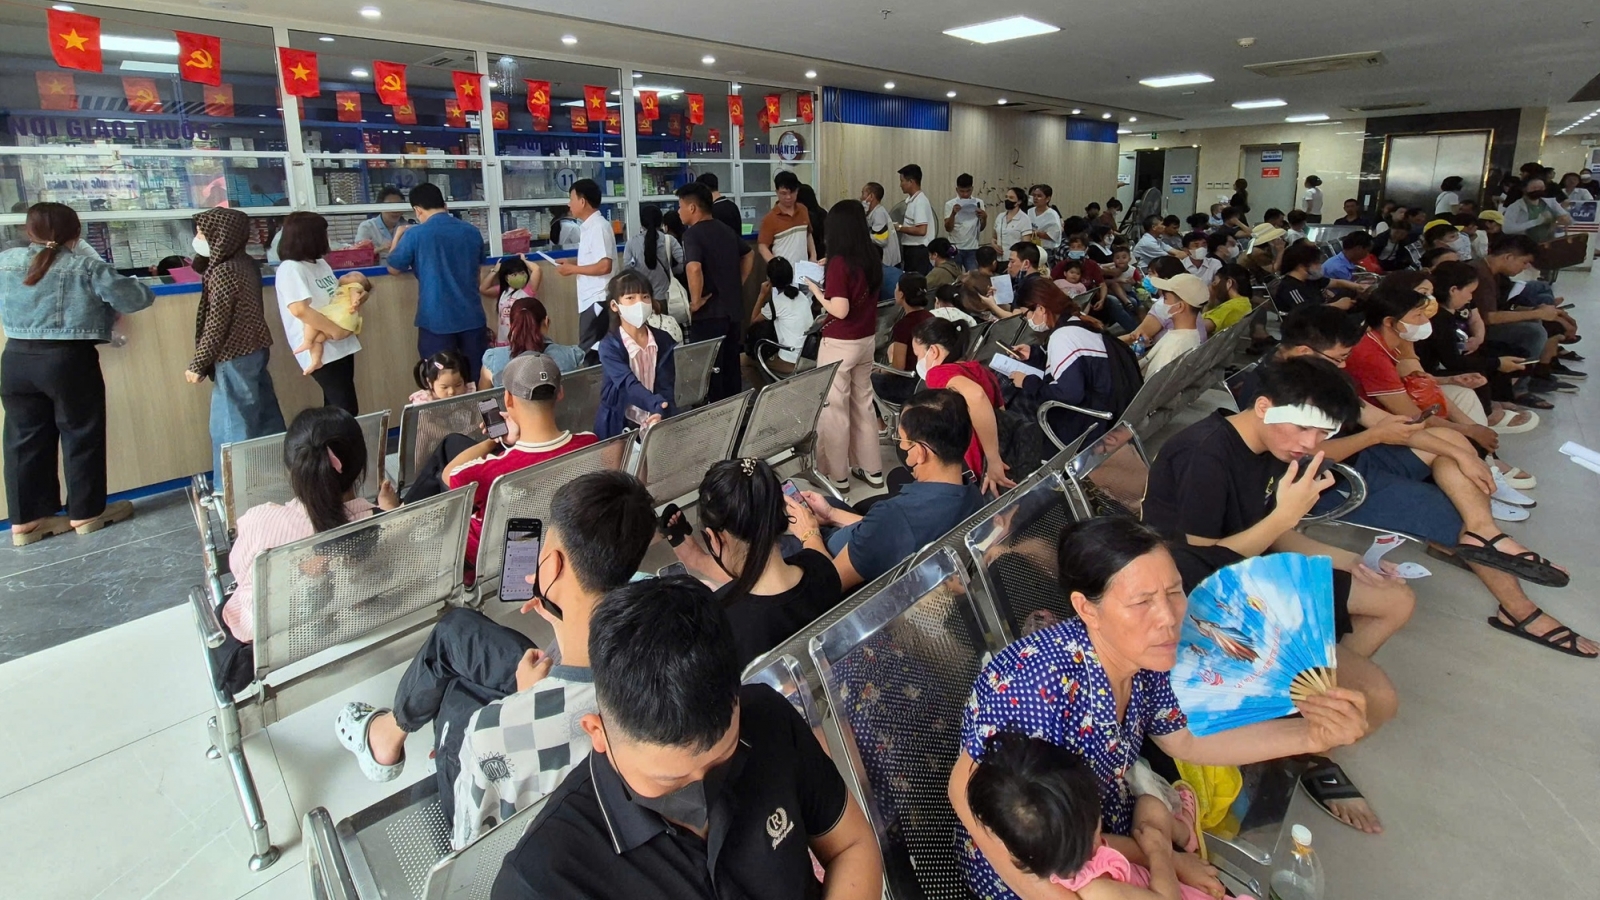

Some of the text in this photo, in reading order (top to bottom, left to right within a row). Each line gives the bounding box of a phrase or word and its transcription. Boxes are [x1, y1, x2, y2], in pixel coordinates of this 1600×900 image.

[66, 118, 127, 139] GIAO
[132, 119, 211, 141] THUỐC
[395, 174, 414, 186] 12
[561, 174, 573, 186] 11
[540, 371, 548, 381] B
[770, 813, 782, 830] R
